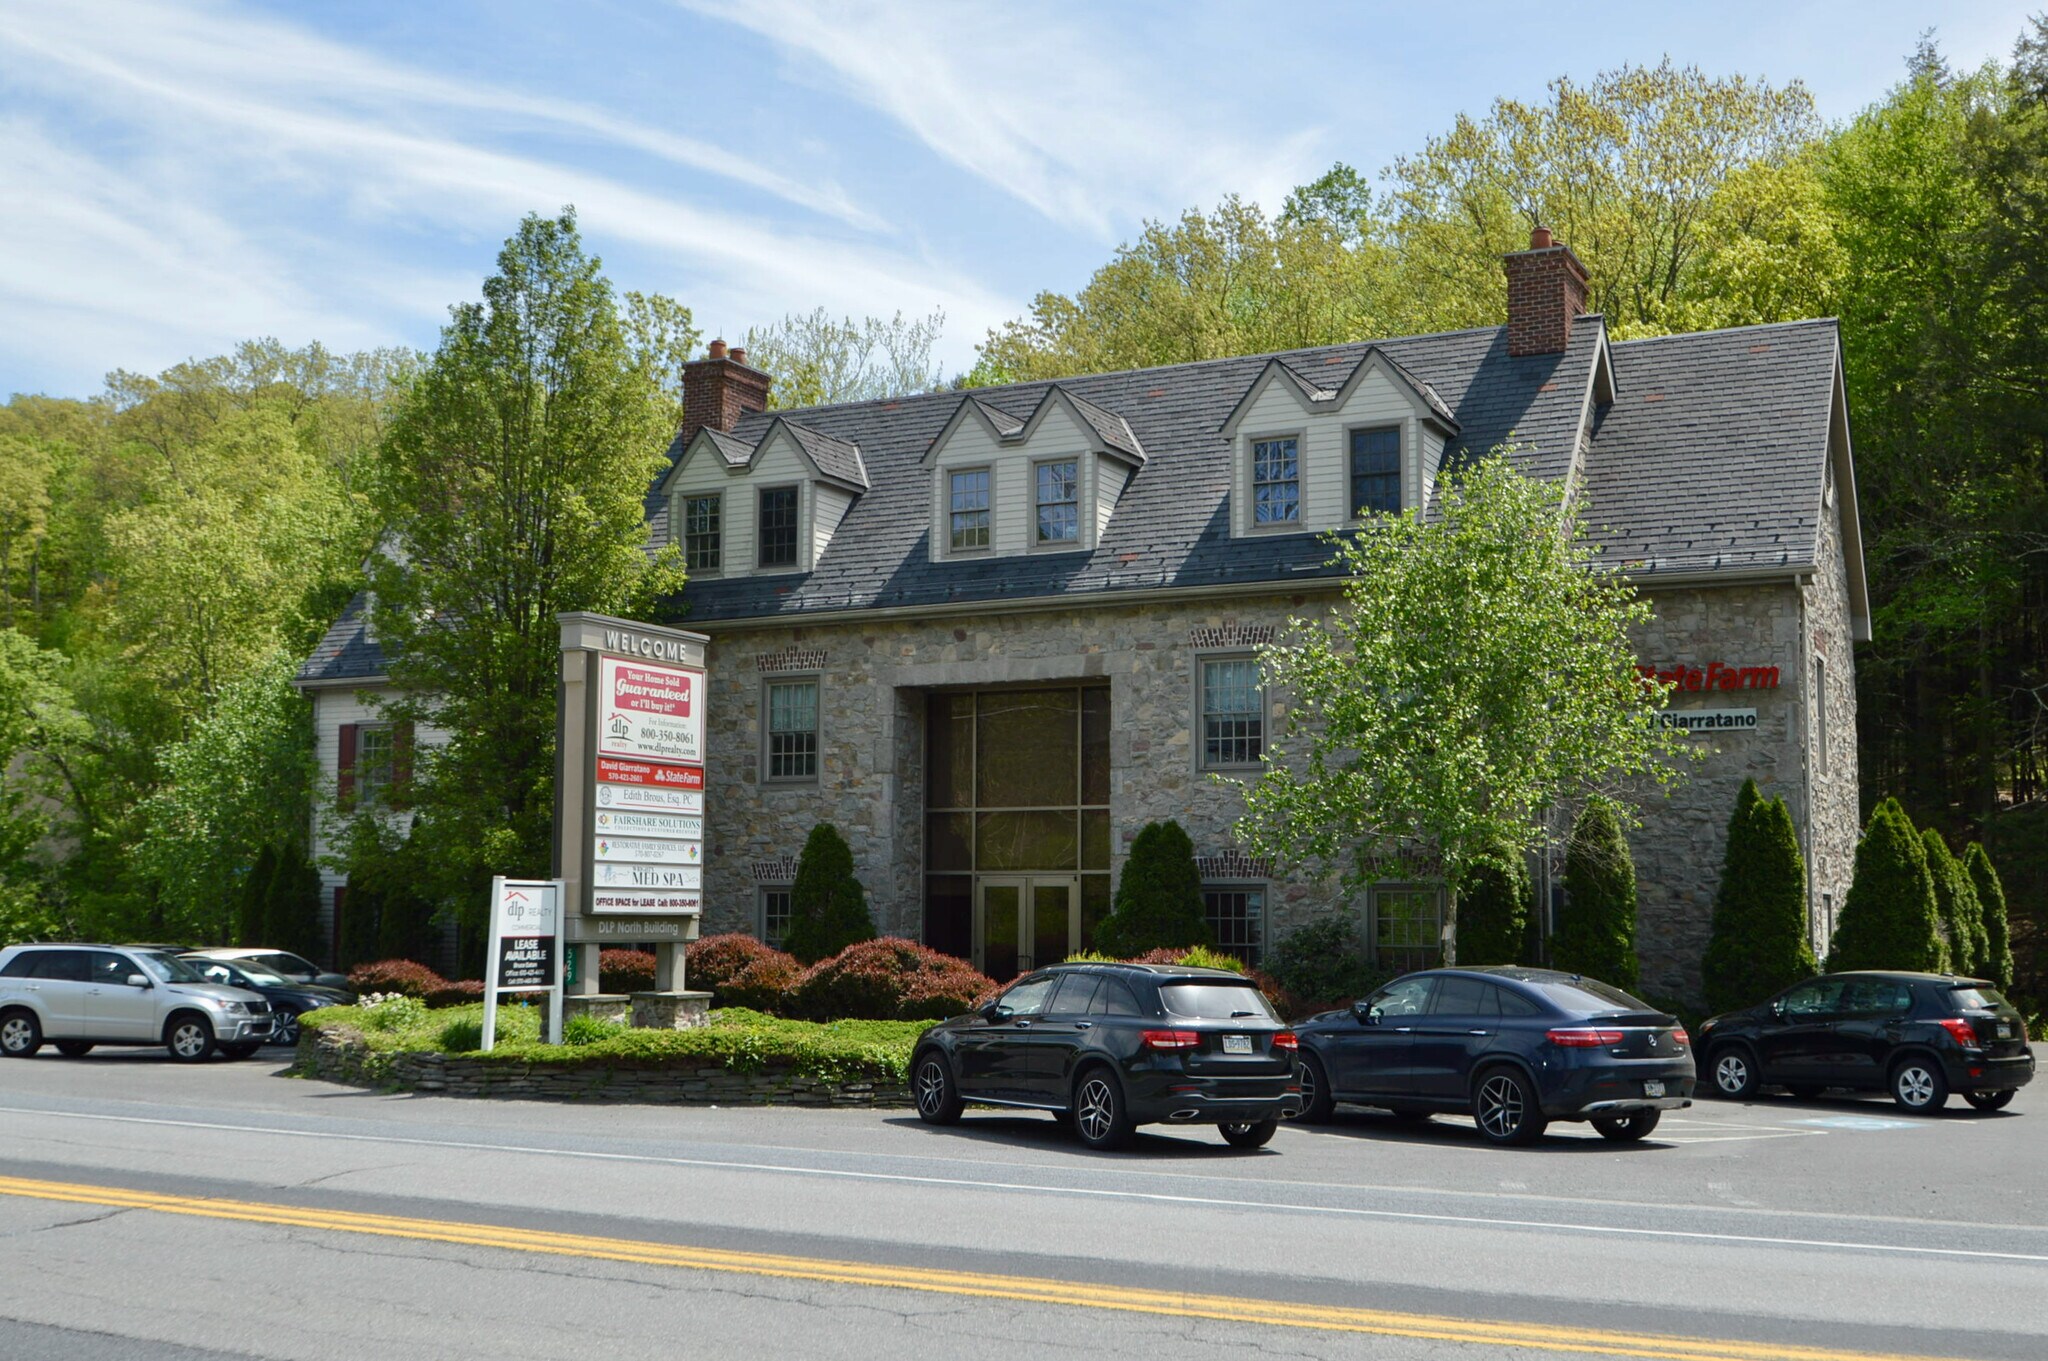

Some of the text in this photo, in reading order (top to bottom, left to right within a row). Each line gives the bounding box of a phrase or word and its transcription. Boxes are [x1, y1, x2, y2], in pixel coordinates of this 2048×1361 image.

[605, 630, 687, 661] WELCOME
[627, 670, 680, 687] Your Home Sold
[616, 678, 690, 702] Guaranteed
[631, 699, 640, 708] or
[640, 699, 650, 709] I'll
[651, 700, 664, 713] buy
[611, 719, 629, 738] dlp
[649, 718, 658, 727] For
[1660, 713, 1757, 729] Giarratano
[641, 727, 695, 745] 800-350-8061
[611, 741, 628, 750] realty
[637, 741, 697, 757] www.dlprealty.com
[601, 760, 651, 774] David Giarratano
[623, 789, 642, 801] Edith
[644, 791, 666, 804] Brous,
[683, 794, 693, 805] PC
[613, 815, 701, 830] FAIRSHARE SOLUTIONS
[611, 841, 641, 850] RESTORATIVE
[641, 842, 656, 850] FAMILY
[632, 871, 684, 886] MED SPA
[595, 897, 614, 907] OFFICE
[615, 897, 631, 907] SPACE
[640, 898, 656, 907] LEASE
[508, 901, 553, 921] dlp REALTY
[598, 921, 679, 936] DLP North Building
[514, 939, 539, 950] LEASE
[504, 950, 547, 961] AVAILABLE
